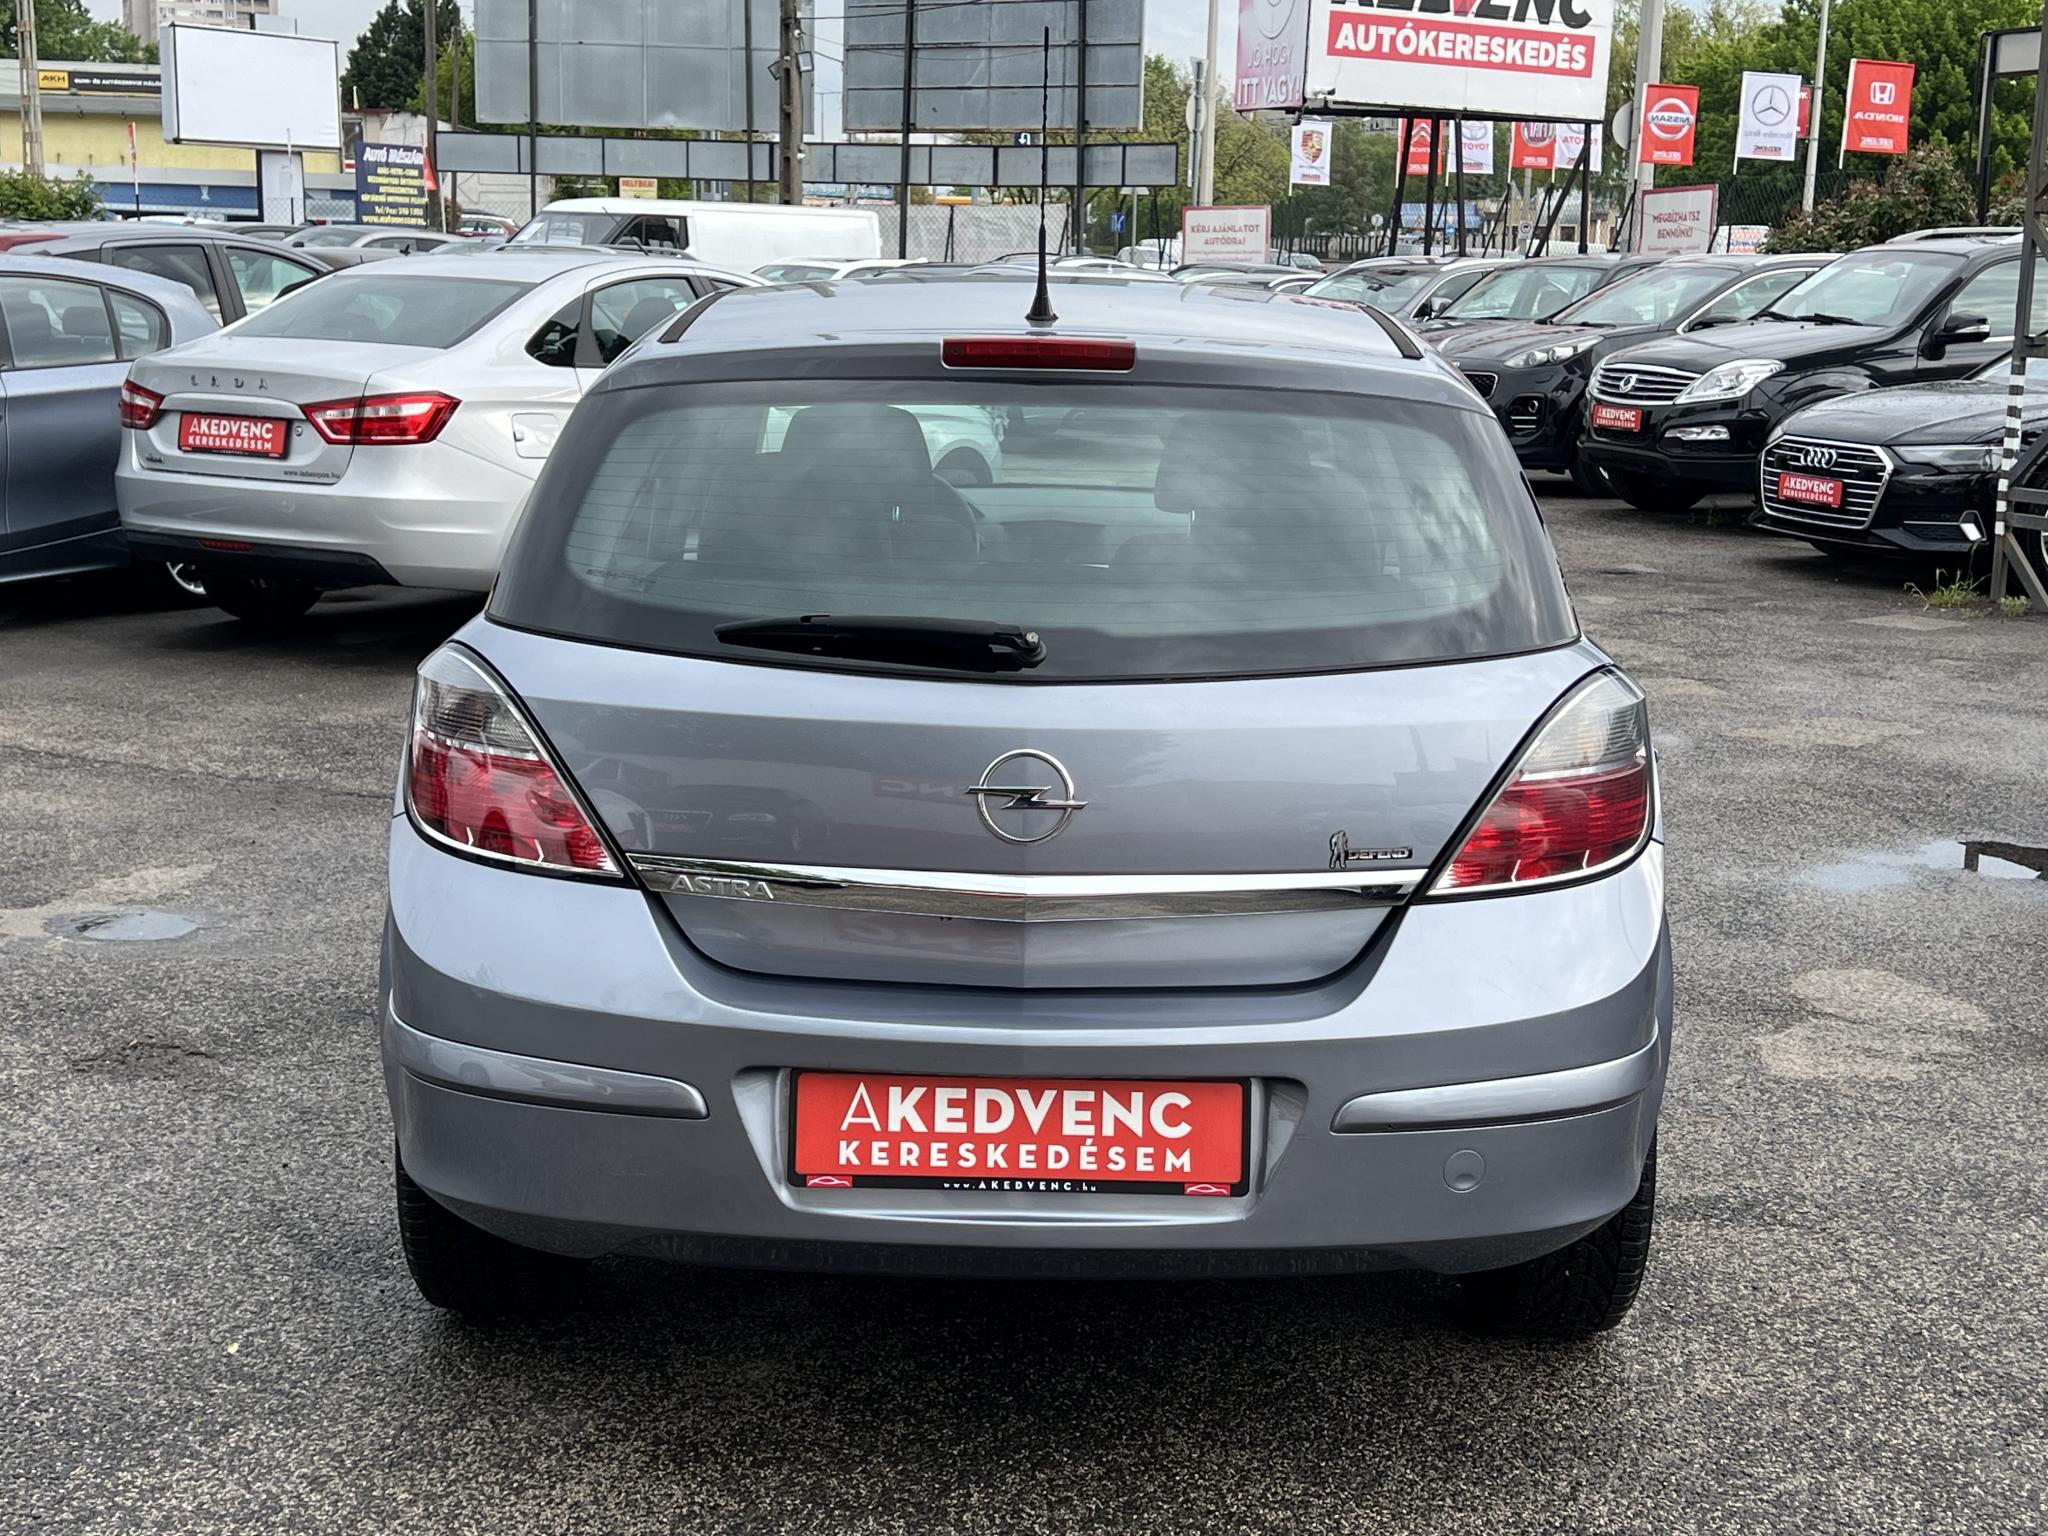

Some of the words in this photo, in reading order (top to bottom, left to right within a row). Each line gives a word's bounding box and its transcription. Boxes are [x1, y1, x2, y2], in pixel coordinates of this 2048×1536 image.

[1334, 21, 1587, 71] AUTÓKERESKEDÉS
[1266, 43, 1295, 68] HOGY
[1238, 78, 1259, 106] ITT
[1262, 74, 1303, 104] VAGY!
[1652, 210, 1701, 223] MEGBÍZHATSZ
[1212, 223, 1260, 233] AJÁNLATOT
[191, 374, 268, 390] LADA
[188, 435, 272, 450] KERESKEDÉSEM
[1347, 848, 1410, 860] DEFEND
[670, 874, 774, 899] ASTRA
[838, 1138, 1192, 1173] KERESKEDÉSEM
[943, 1180, 1097, 1192] www.AKEDVENC.hu
